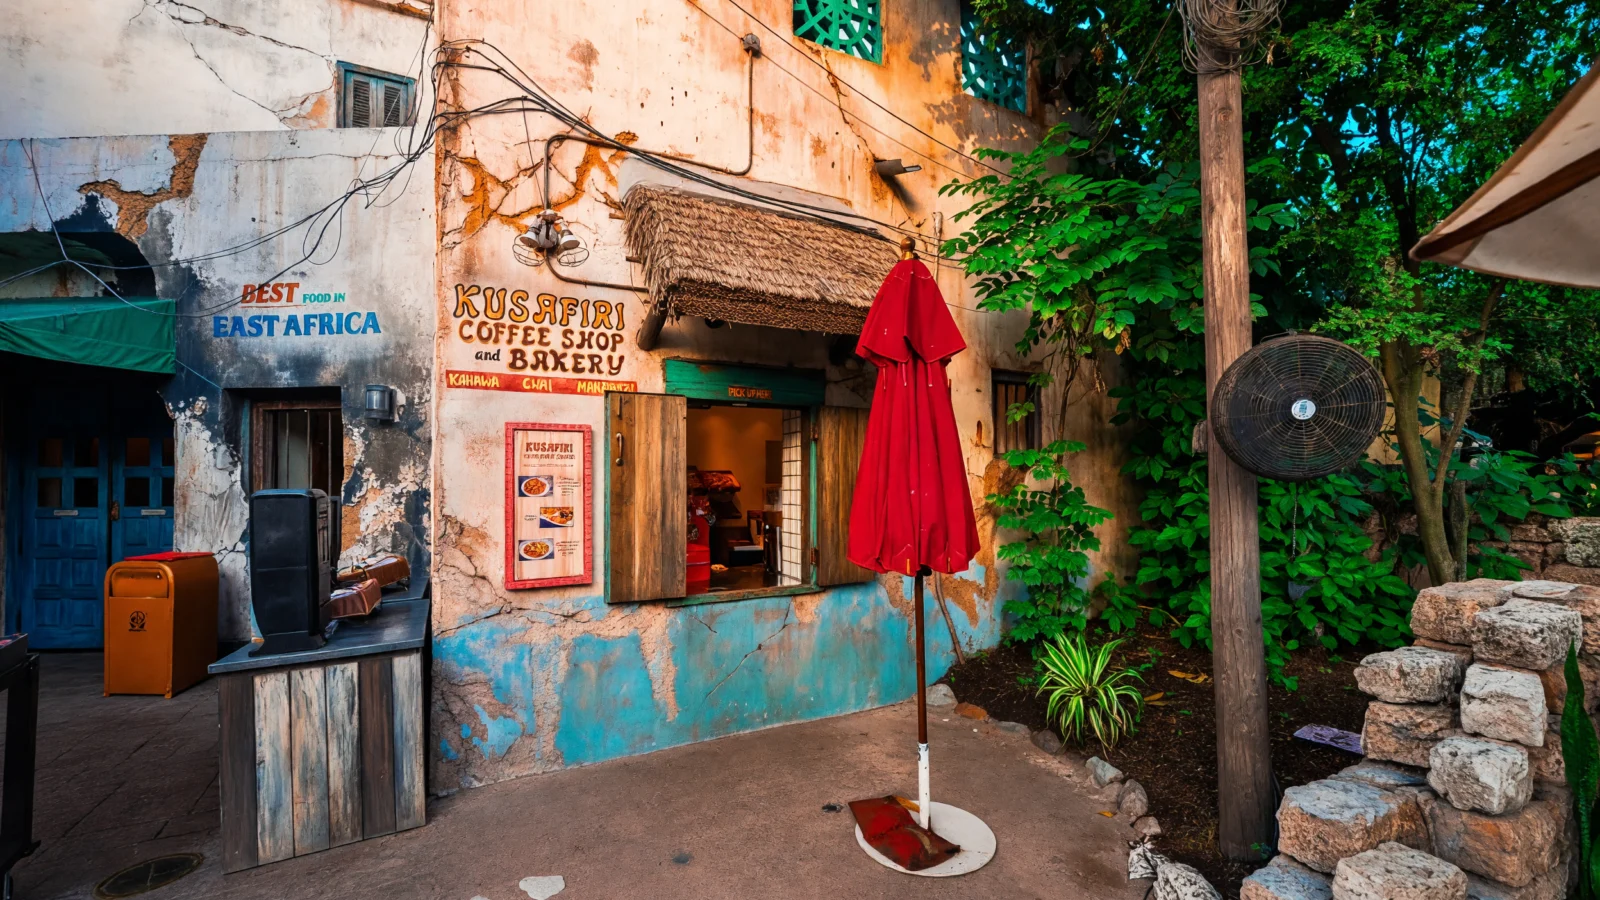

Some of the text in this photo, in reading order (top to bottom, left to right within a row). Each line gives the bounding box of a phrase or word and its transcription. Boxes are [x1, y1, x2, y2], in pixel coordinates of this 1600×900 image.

[241, 282, 346, 304] BEST FOOD IN
[453, 283, 625, 331] KUSAFIRI
[213, 311, 381, 337] EAST AFRICA
[458, 319, 624, 352] COFFEE SHOP
[475, 348, 625, 375] and BAKERY
[448, 373, 500, 388] KAHAWA
[522, 377, 552, 392] CHAI
[728, 387, 745, 398] PICK
[746, 389, 756, 398] UP
[525, 442, 573, 453] KUSAFIRI
